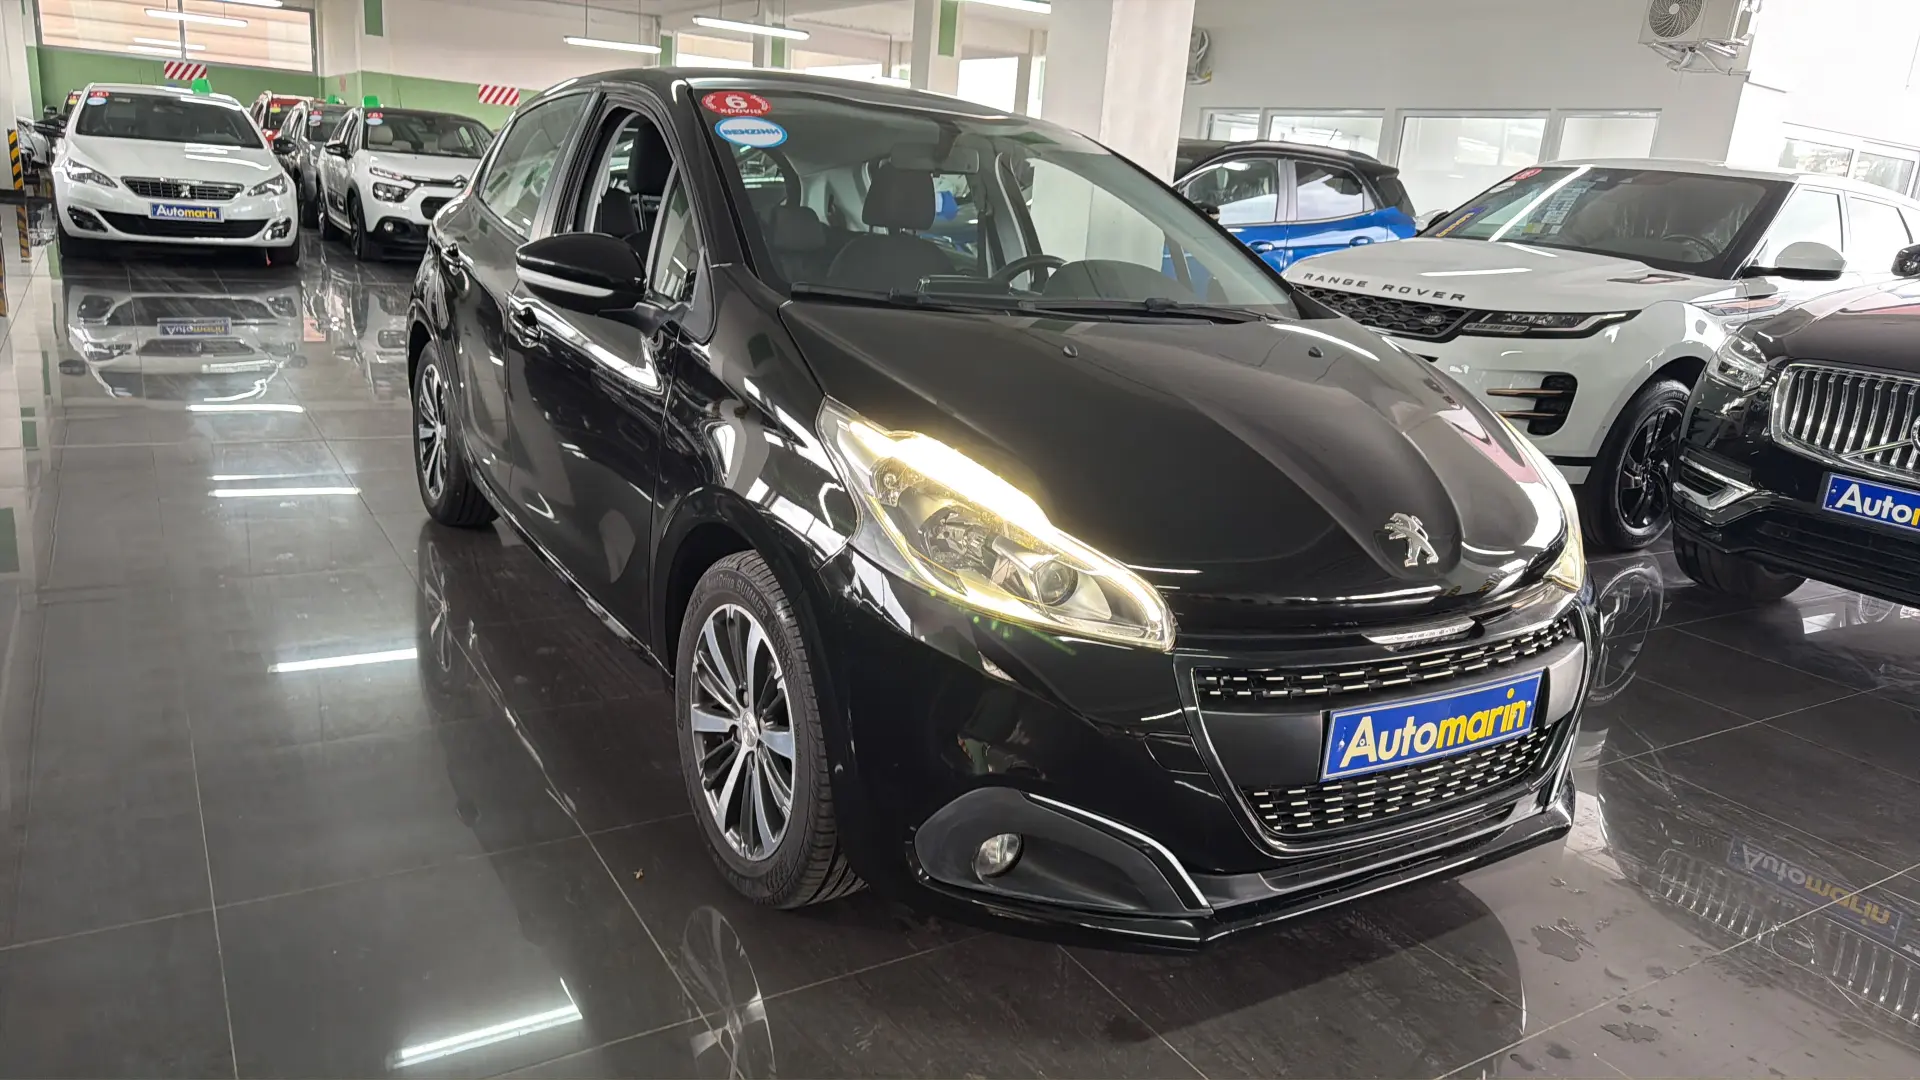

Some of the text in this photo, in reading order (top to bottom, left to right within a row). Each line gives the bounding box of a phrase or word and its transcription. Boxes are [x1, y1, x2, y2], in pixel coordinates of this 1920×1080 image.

[156, 204, 217, 219] Automarin
[1303, 273, 1467, 302] RANGE ROVER
[736, 579, 768, 620] SUMMER
[1339, 688, 1527, 768] Automarin
